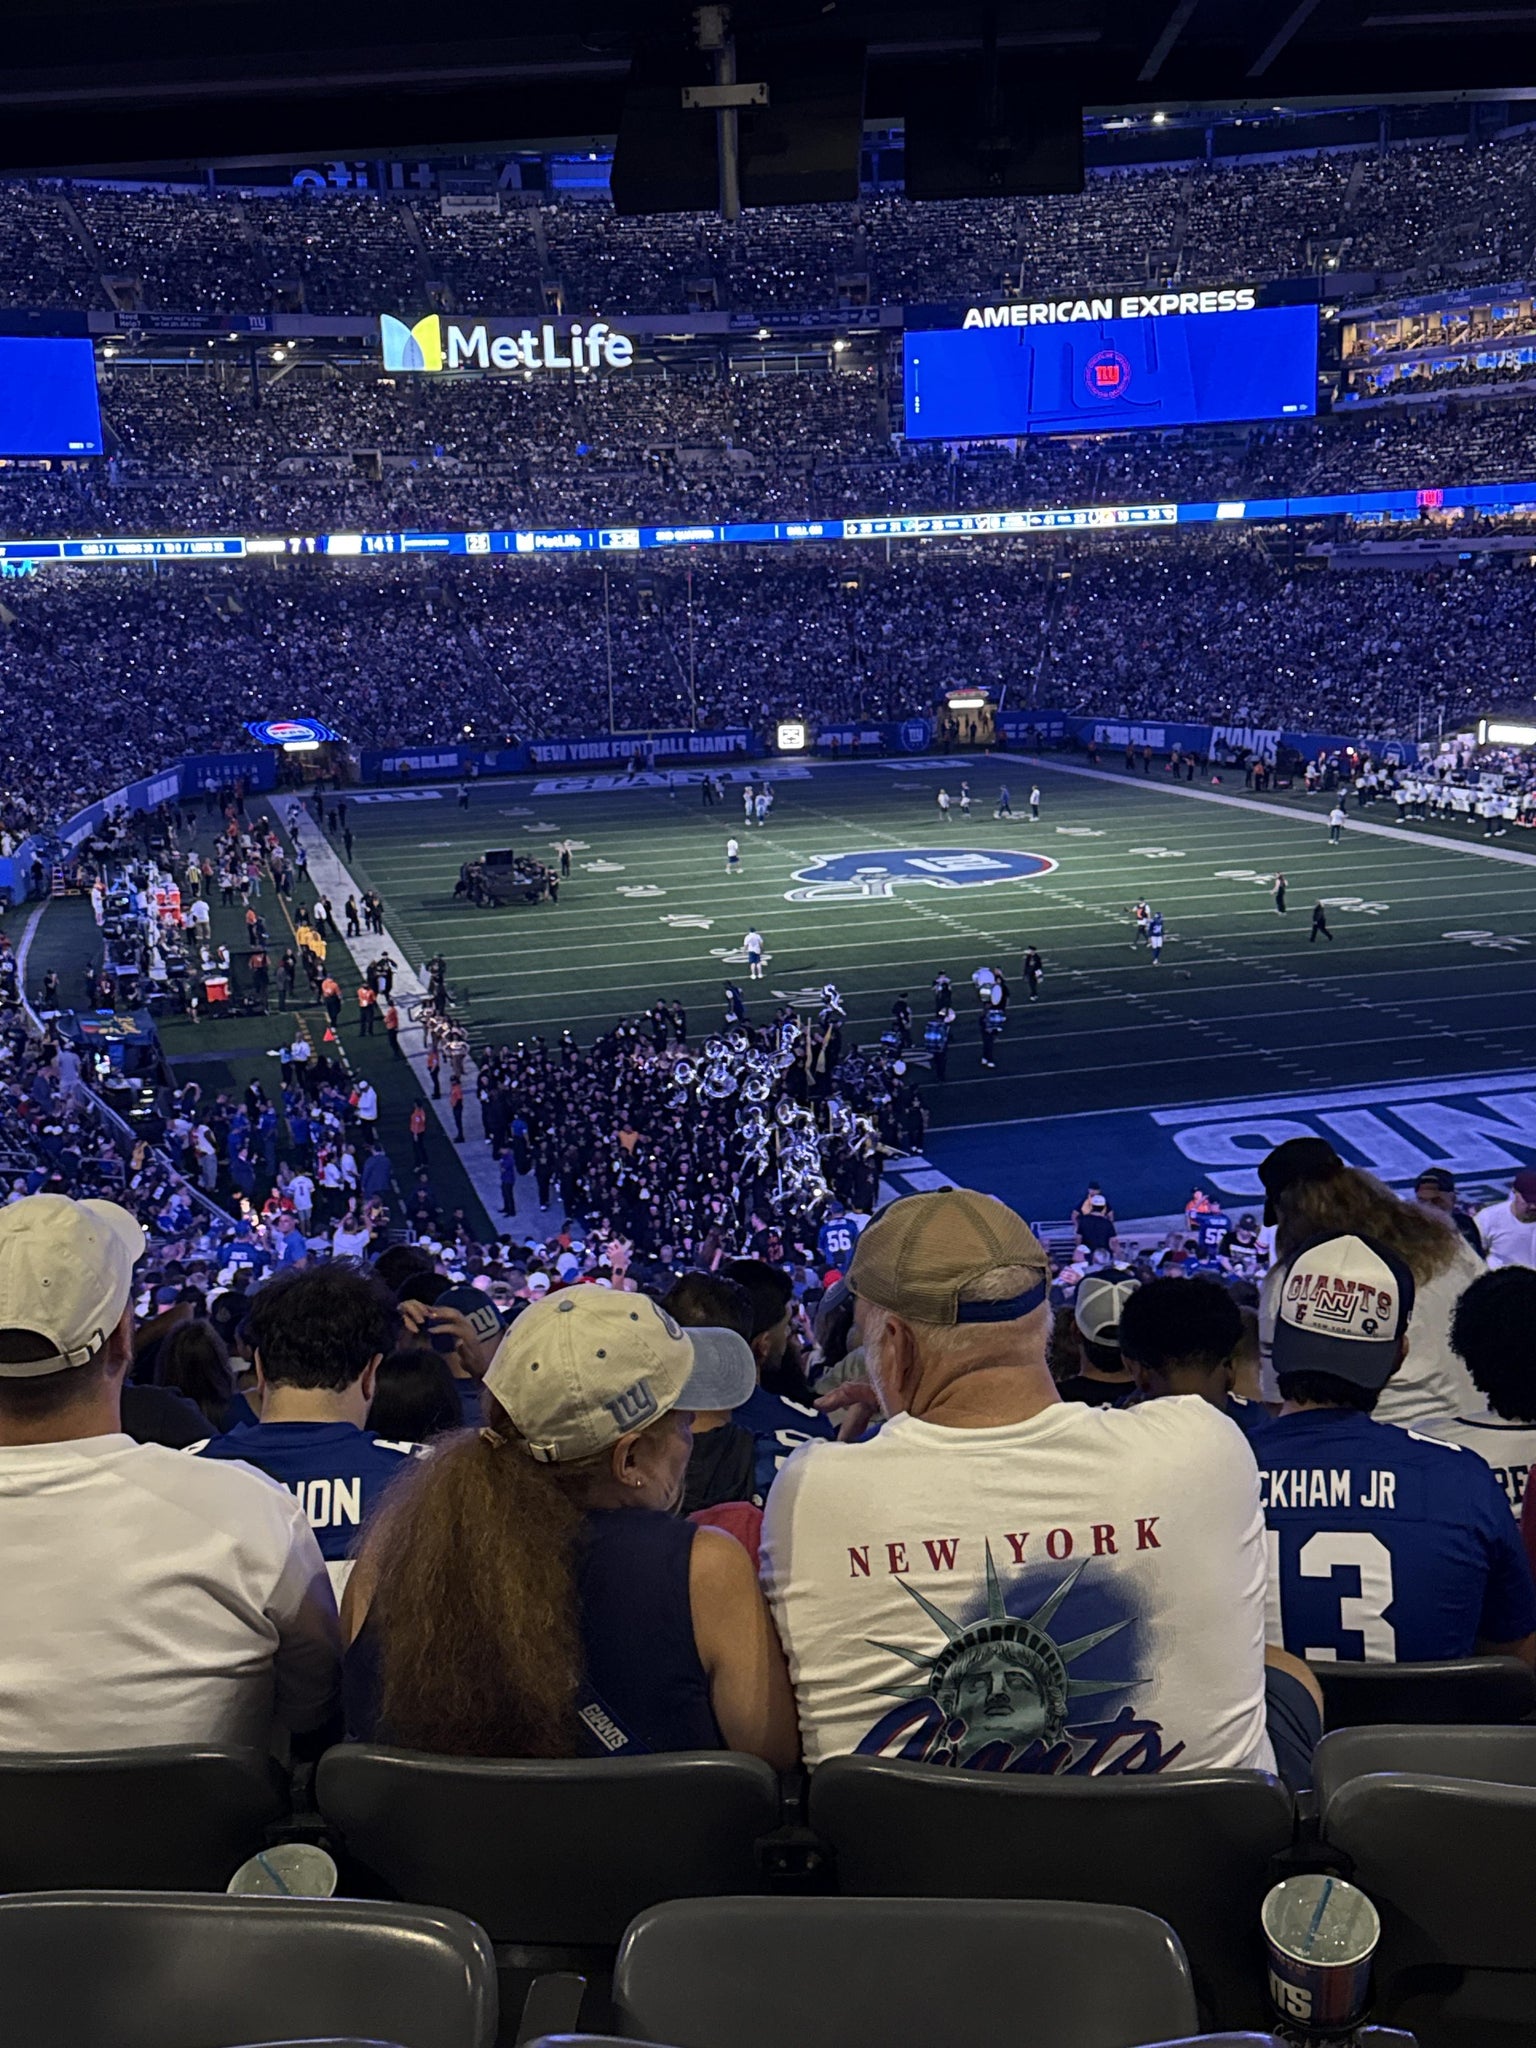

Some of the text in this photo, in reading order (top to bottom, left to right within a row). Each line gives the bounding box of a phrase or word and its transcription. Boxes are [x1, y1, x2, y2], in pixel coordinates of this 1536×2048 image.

[962, 288, 1256, 329] AMERICAN EXPRESS
[447, 323, 634, 368] MetLife
[568, 741, 610, 759] YORK
[689, 734, 748, 753] GIANTS
[826, 1228, 852, 1253] 56
[1287, 1274, 1393, 1320] GIANTS
[1360, 1470, 1397, 1510] JR
[847, 1516, 1163, 1578] NEW YORK
[582, 1702, 630, 1750] GIANTS
